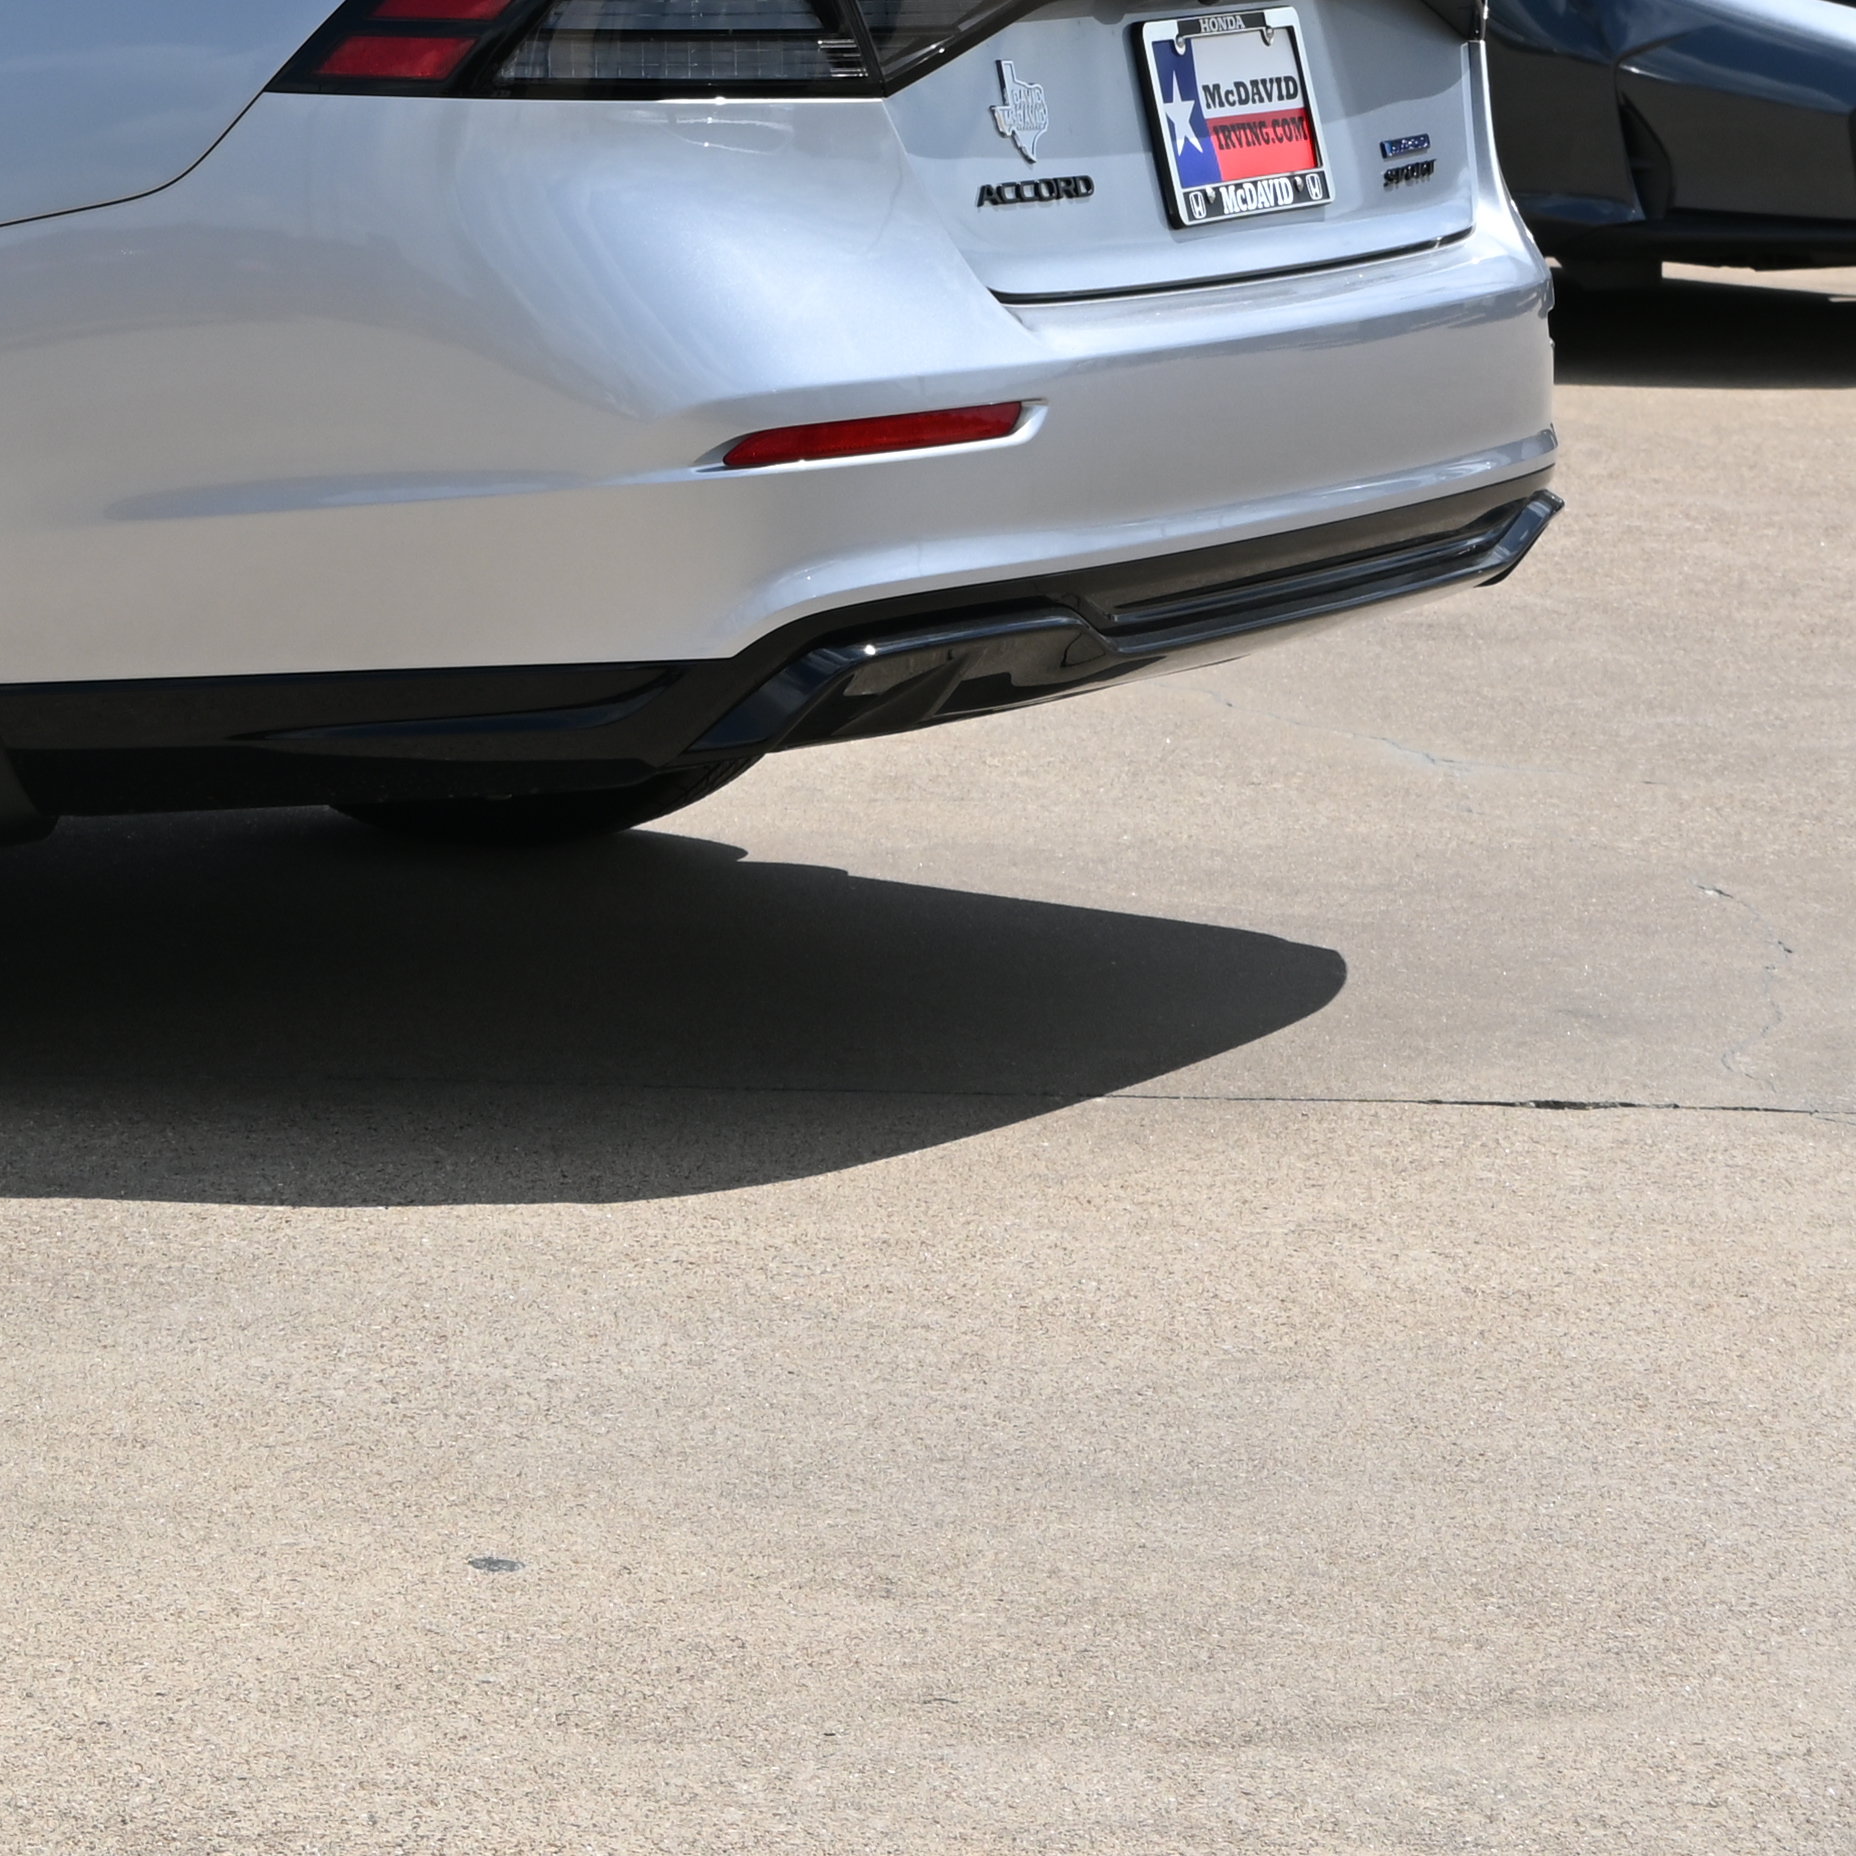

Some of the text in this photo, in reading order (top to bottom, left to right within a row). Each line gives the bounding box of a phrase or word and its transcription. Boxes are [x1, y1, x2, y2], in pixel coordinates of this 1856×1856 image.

[1199, 15, 1246, 33] HONDA
[1202, 75, 1299, 110] McDAVID
[1212, 115, 1309, 151] IRVING.COM
[976, 174, 1095, 208] ACCORD
[1219, 176, 1295, 216] McDAVID
